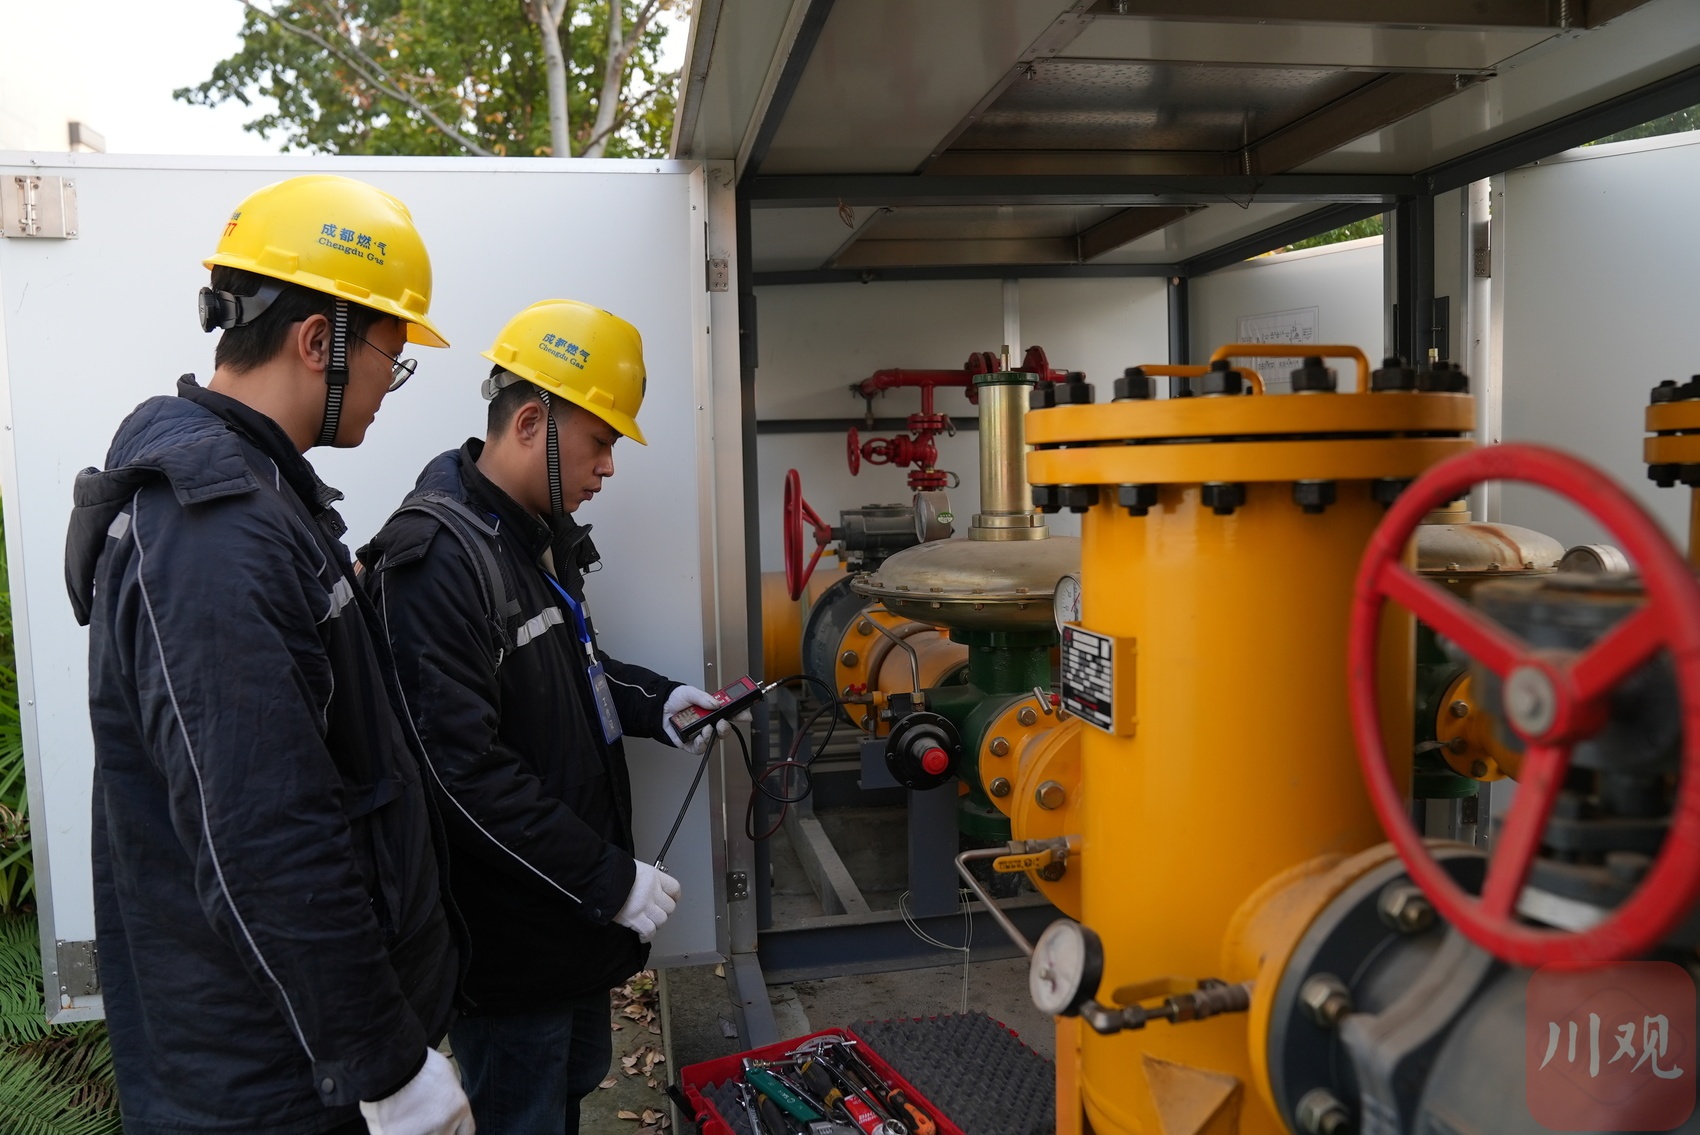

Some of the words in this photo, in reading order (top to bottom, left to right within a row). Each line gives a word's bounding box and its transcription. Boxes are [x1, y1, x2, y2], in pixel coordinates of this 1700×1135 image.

[318, 236, 364, 258] Chengdu
[366, 252, 385, 266] Gas
[321, 223, 387, 256] 成都燃气
[538, 342, 569, 362] Chengdu
[569, 357, 585, 370] Gas
[542, 333, 591, 363] 成都燃气
